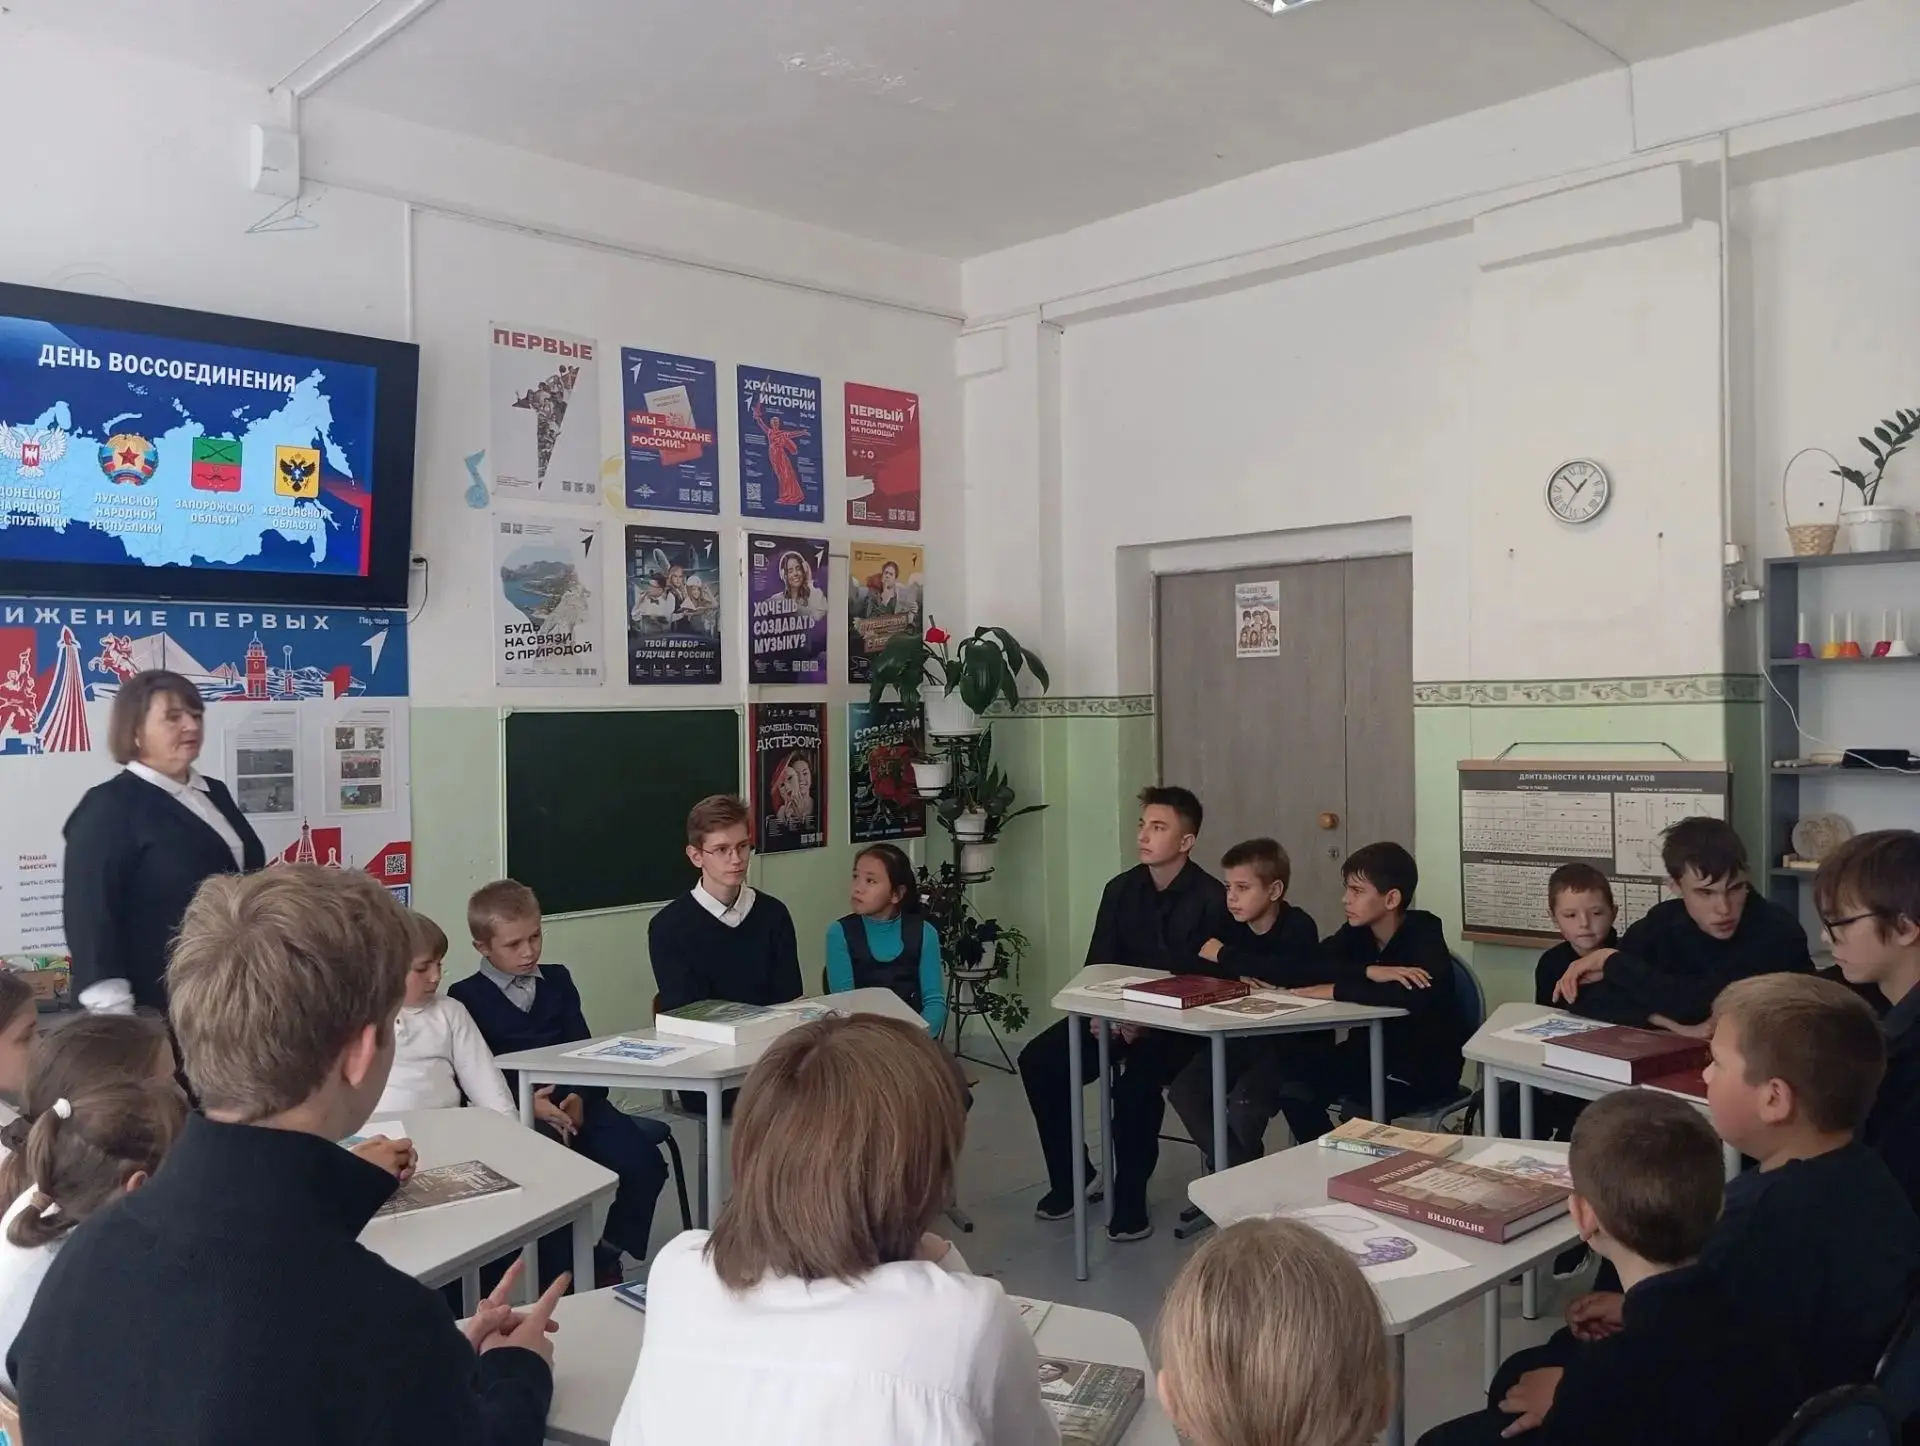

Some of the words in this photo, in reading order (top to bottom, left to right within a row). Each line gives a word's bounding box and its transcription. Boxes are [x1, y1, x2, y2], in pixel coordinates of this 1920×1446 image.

[493, 328, 593, 360] ПЕРВЫЕ
[38, 344, 101, 369] ДЕНЬ
[108, 352, 297, 393] ВОССОЕДИНЕНИЯ
[744, 379, 815, 400] ХРАНИТЕЛИ
[760, 394, 816, 411] ИСТОРИИ
[631, 414, 657, 426] «МЫ
[849, 404, 904, 422] ПЕРВЫЙ
[632, 435, 686, 449] РОССИИ!»
[653, 427, 712, 443] ГРАЖДАНЕ
[0, 487, 62, 500] ДОНЕЦКОЙ
[94, 493, 159, 507] ЛУГАНСКОЙ
[95, 506, 157, 520] НАРОДНОЙ
[175, 499, 255, 516] ЗАПОРОЖСКОЙ
[263, 504, 330, 520] ХЕРСОНСКОЙ
[88, 519, 163, 534] РЕСПУБЛИКИ
[191, 513, 239, 526] ОБЛАСТИ
[272, 519, 319, 532] ОБЛАСТИ
[753, 599, 798, 617] ХОЧЕШЬ
[189, 611, 330, 630] ПЕРВЫХ
[753, 615, 815, 635] СОЗДАВАТЬ
[504, 623, 541, 634] БУДЬ
[504, 637, 524, 647] НА
[526, 632, 572, 645] СВЯЗИ
[644, 638, 667, 648] ТВОЙ
[669, 640, 699, 648] ВЫБОР
[754, 633, 807, 654] МУЗЫКУ?
[505, 651, 515, 660] С
[517, 640, 592, 660] ПРИРОДОЙ
[635, 650, 676, 659] БУДУЩЕЕ
[677, 650, 714, 659] РОССИИ!
[793, 723, 818, 733] СТАТЬ
[756, 734, 822, 752] АКТЁРОМ?
[1519, 773, 1577, 781] ДЛИТЕЛЬНОСТИ
[1587, 774, 1623, 782] РАЗМЕРЫ
